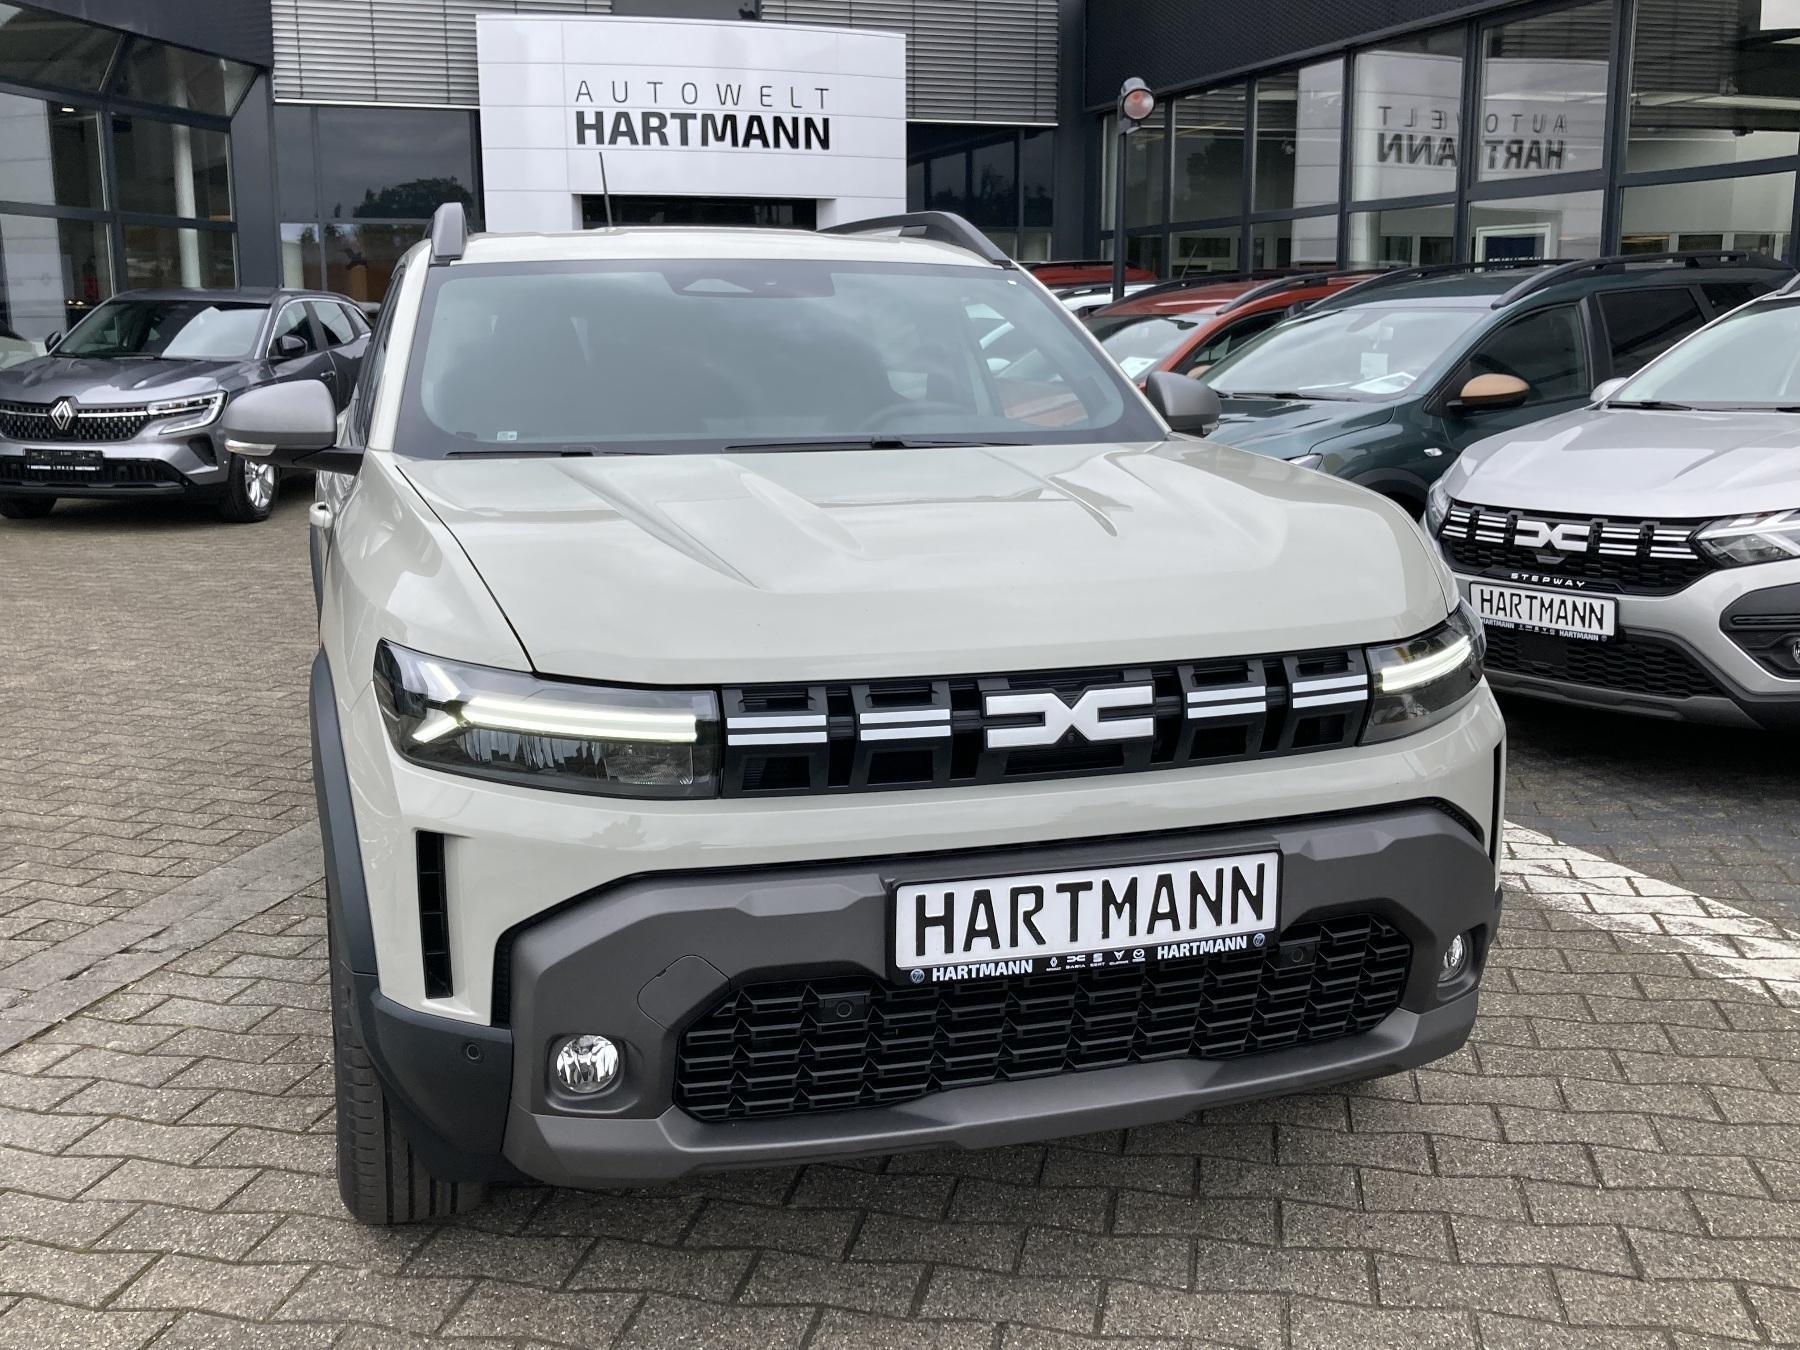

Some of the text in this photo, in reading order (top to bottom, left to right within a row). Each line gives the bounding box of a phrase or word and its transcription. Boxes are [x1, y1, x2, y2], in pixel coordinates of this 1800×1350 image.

[575, 80, 831, 109] AUTOWELT
[575, 110, 831, 151] HARTMANN
[1510, 572, 1585, 588] STEPWAY
[1479, 588, 1605, 631] HARTMANN
[1559, 629, 1600, 641] HARTMANN
[915, 862, 1265, 957] HARTMANN
[932, 959, 1033, 982] HARTMANN
[1157, 935, 1247, 960] HARTMANN
